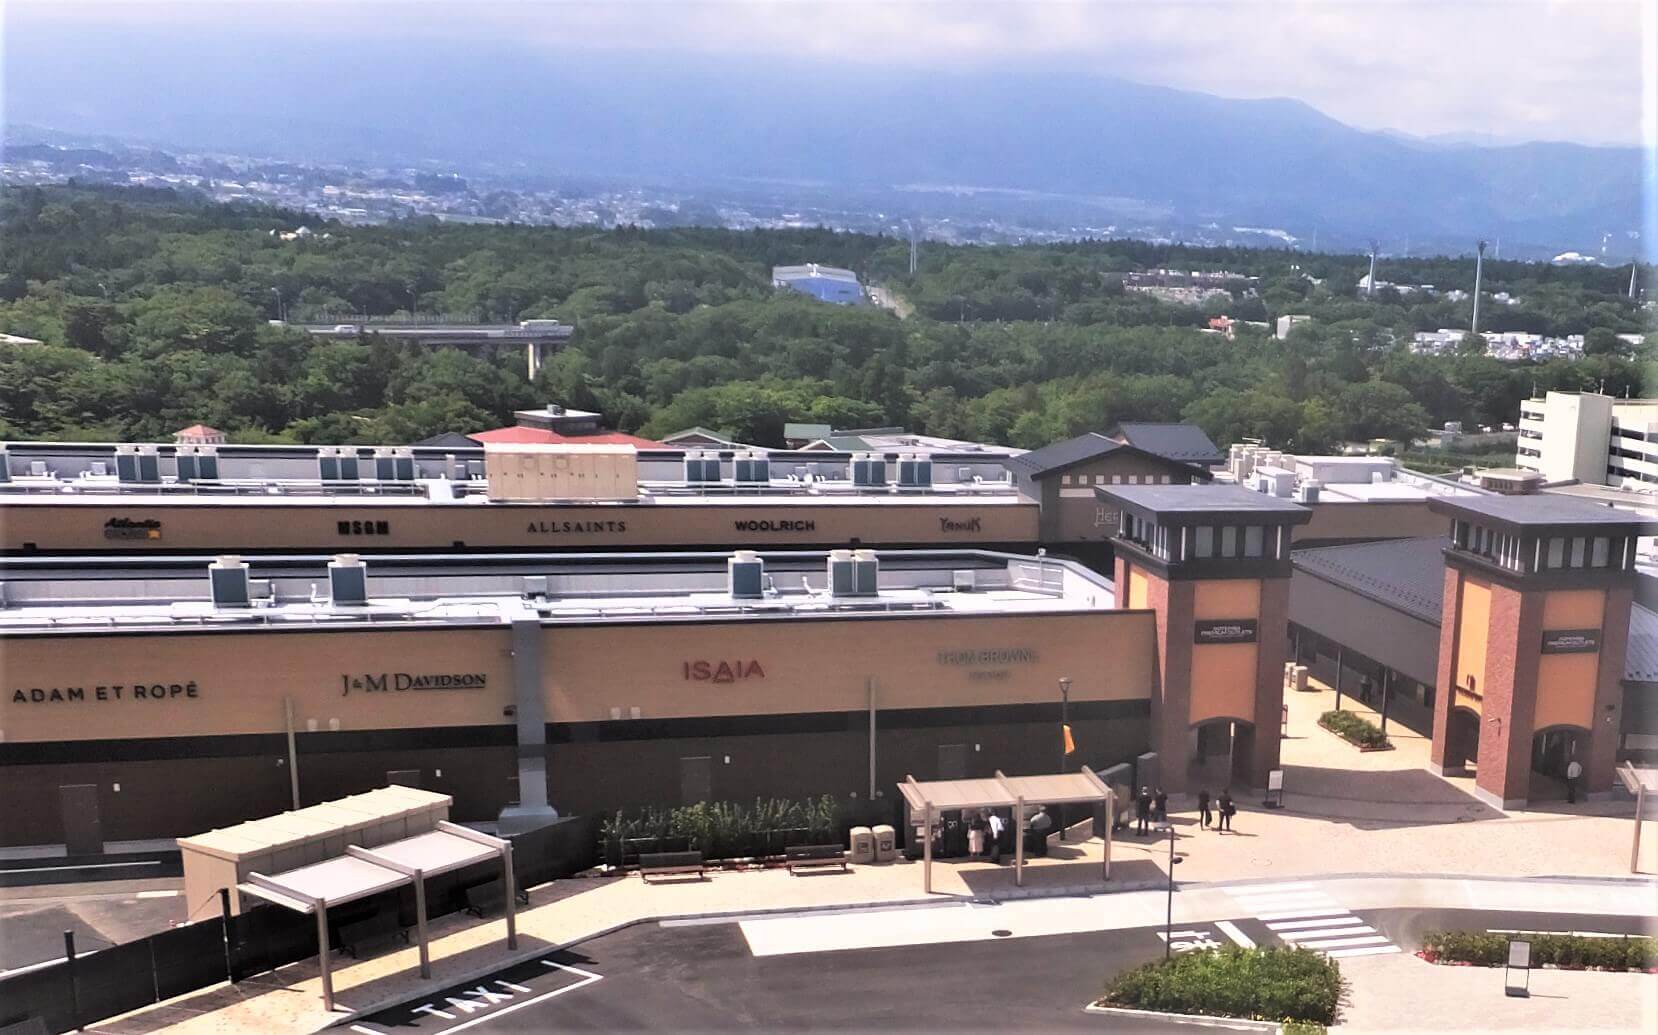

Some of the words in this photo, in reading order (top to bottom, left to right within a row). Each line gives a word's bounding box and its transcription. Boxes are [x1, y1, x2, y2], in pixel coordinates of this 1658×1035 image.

[527, 520, 627, 533] ALLSAINTS
[734, 520, 816, 532] WOOLRICH
[683, 659, 766, 684] ISAIA
[13, 687, 86, 703] ADAM
[95, 685, 124, 700] ET
[411, 980, 532, 1020] TAXI
